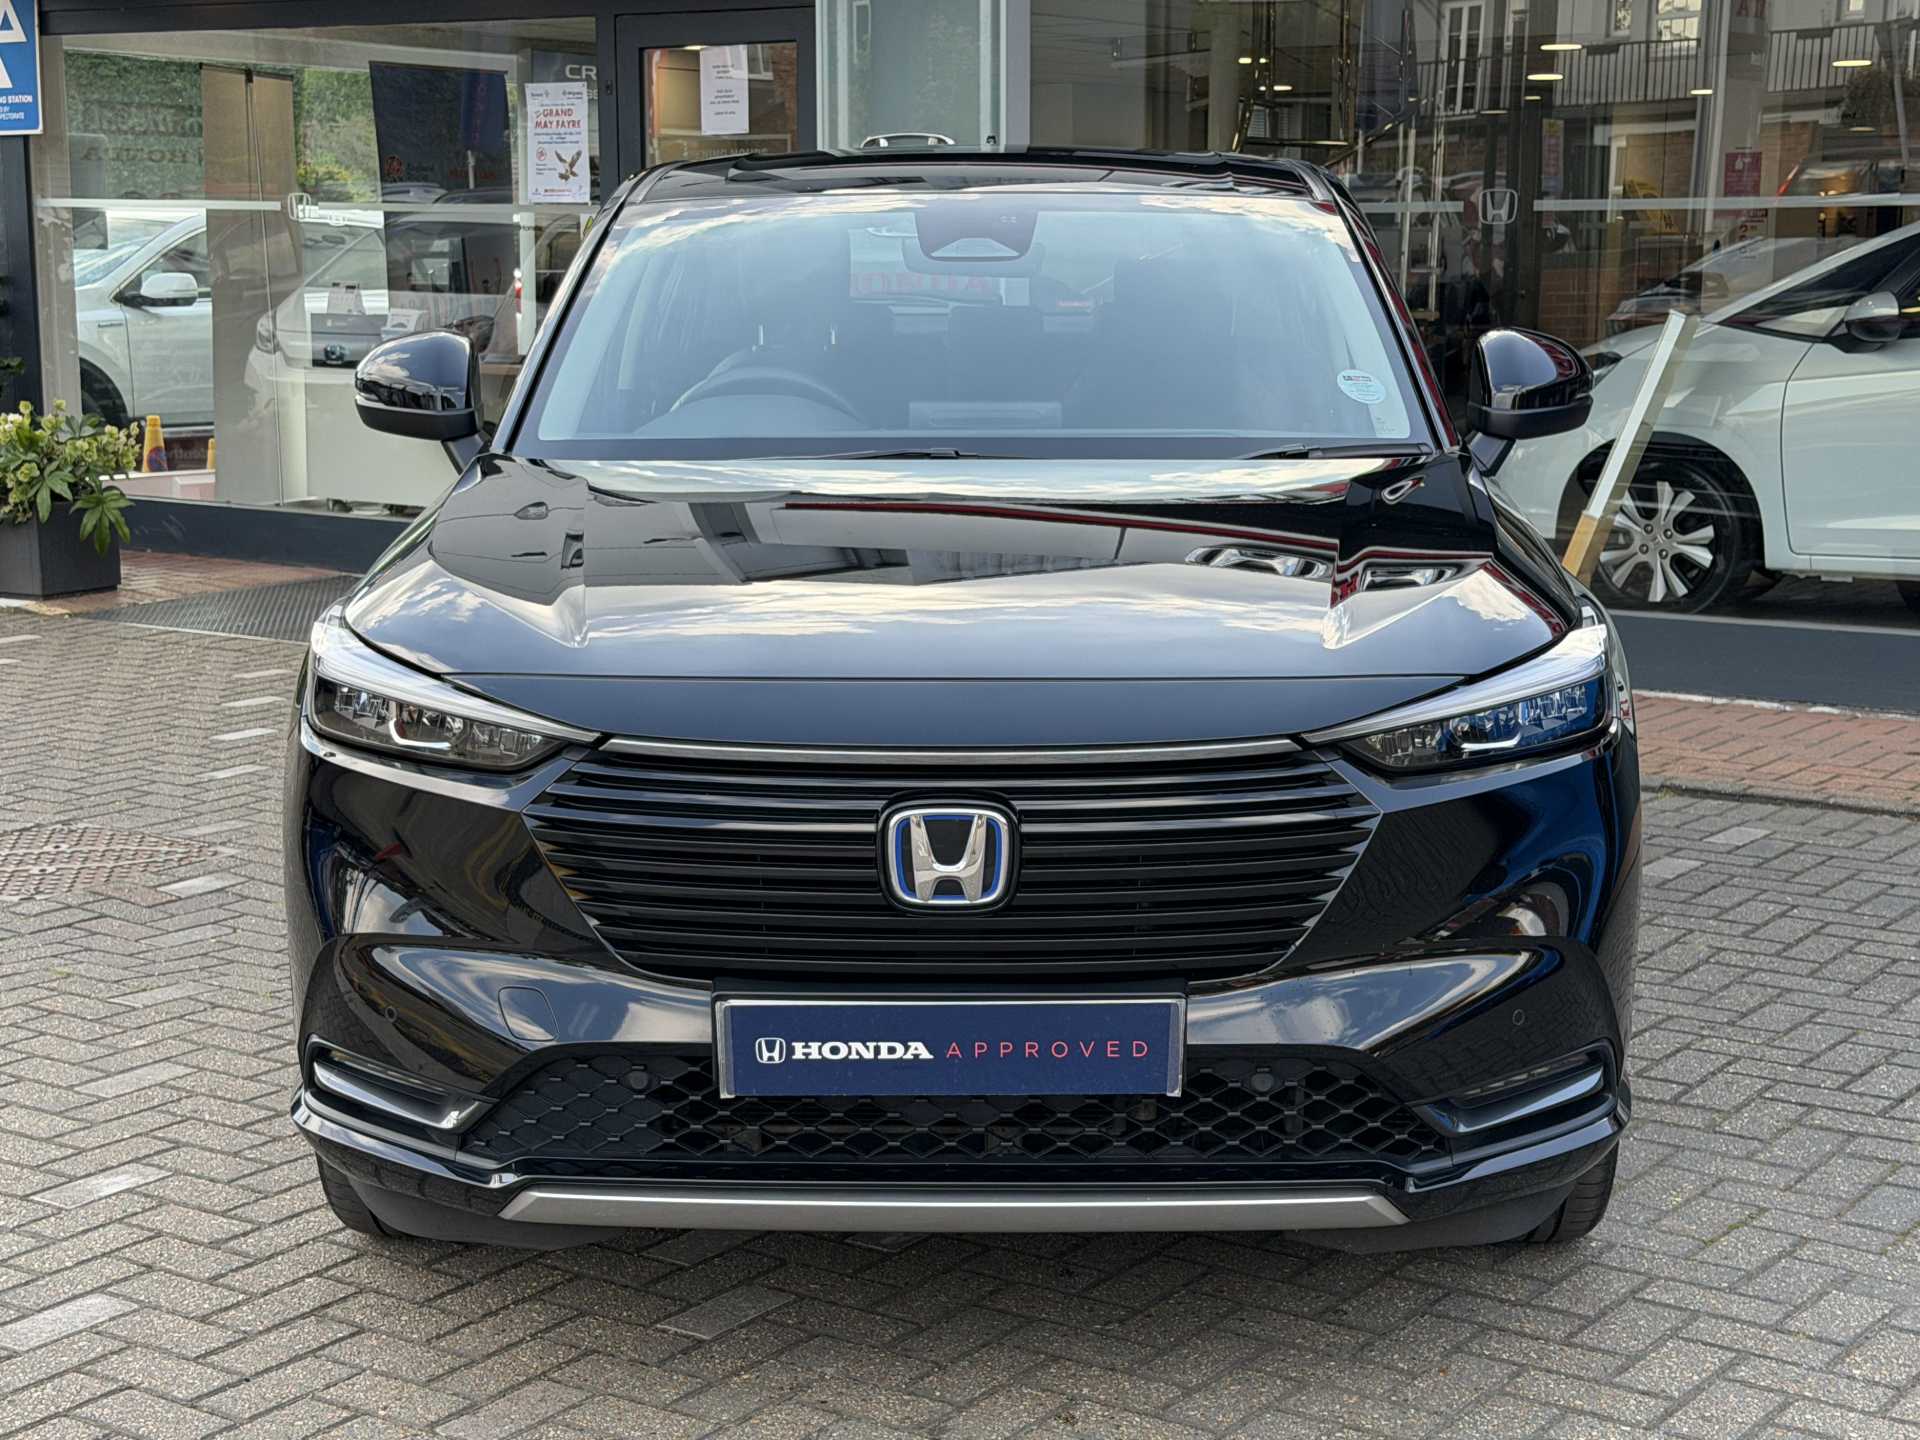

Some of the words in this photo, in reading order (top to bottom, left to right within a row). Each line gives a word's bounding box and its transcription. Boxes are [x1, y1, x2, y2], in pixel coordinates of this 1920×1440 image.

[8, 95, 33, 103] STATION
[542, 108, 574, 118] GRAND
[535, 119, 553, 129] MAY
[556, 119, 582, 129] FAYRE
[791, 1041, 935, 1060] HONDA
[946, 1040, 1149, 1059] APPROVED
